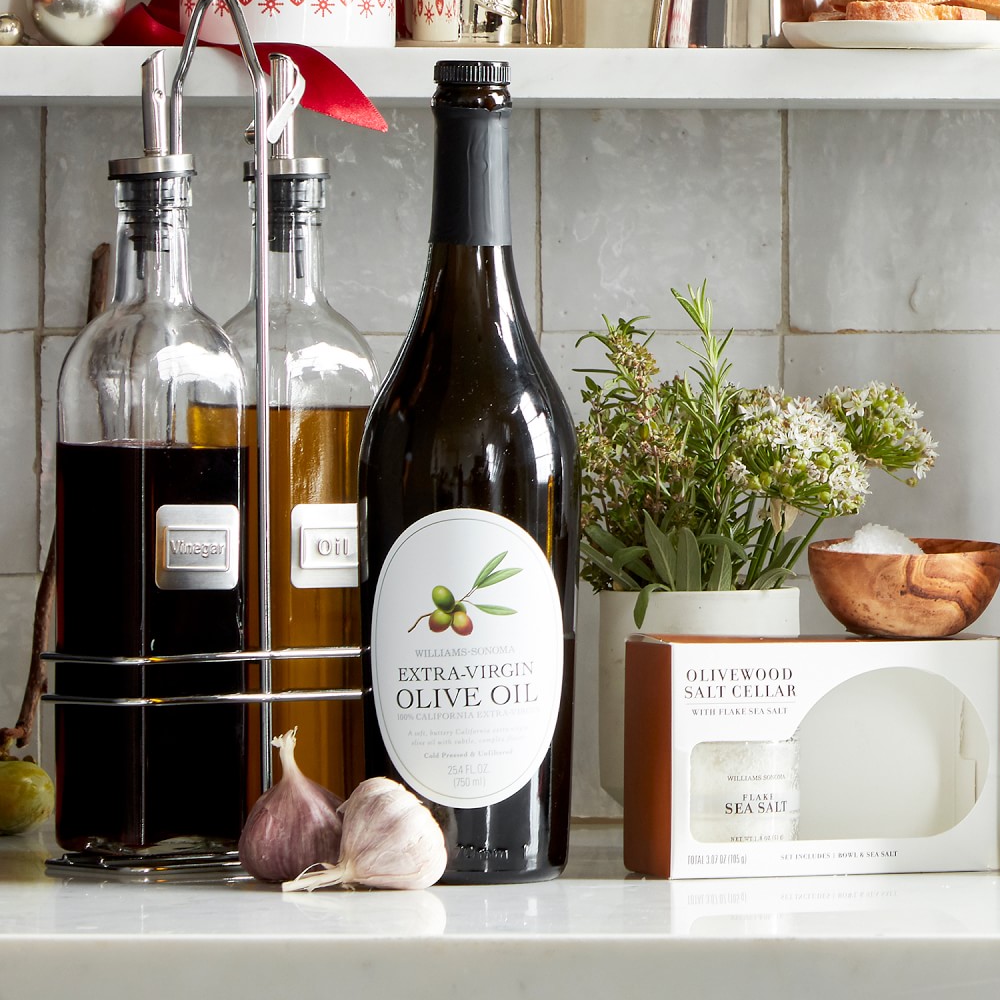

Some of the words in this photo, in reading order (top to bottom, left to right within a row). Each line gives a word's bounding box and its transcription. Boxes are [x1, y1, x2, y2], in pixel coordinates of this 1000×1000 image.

[169, 539, 225, 559] Vinegar
[317, 538, 349, 556] Oil
[414, 645, 516, 658] WILLIAMS-SONOMA
[397, 660, 535, 683] EXTRA-VIRGIN
[686, 667, 794, 683] OLIVEWOOD
[396, 687, 483, 710] OLIVE
[490, 682, 539, 706] OIL
[684, 685, 728, 700] SALT
[731, 684, 798, 699] CELLAR
[396, 712, 415, 721] 100%
[415, 711, 475, 721] CALIFORNIA
[691, 707, 717, 716] WITH
[718, 707, 747, 716] FLAKE
[748, 707, 765, 716] SEA
[766, 706, 788, 716] SALT
[441, 751, 468, 759] Pressed
[447, 764, 463, 775] 25.4
[453, 776, 470, 788] (750
[724, 802, 754, 815] SEA
[757, 800, 788, 813] SALT
[687, 854, 704, 865] TOTAL
[719, 854, 727, 865] OZ
[880, 850, 898, 858] SALT
